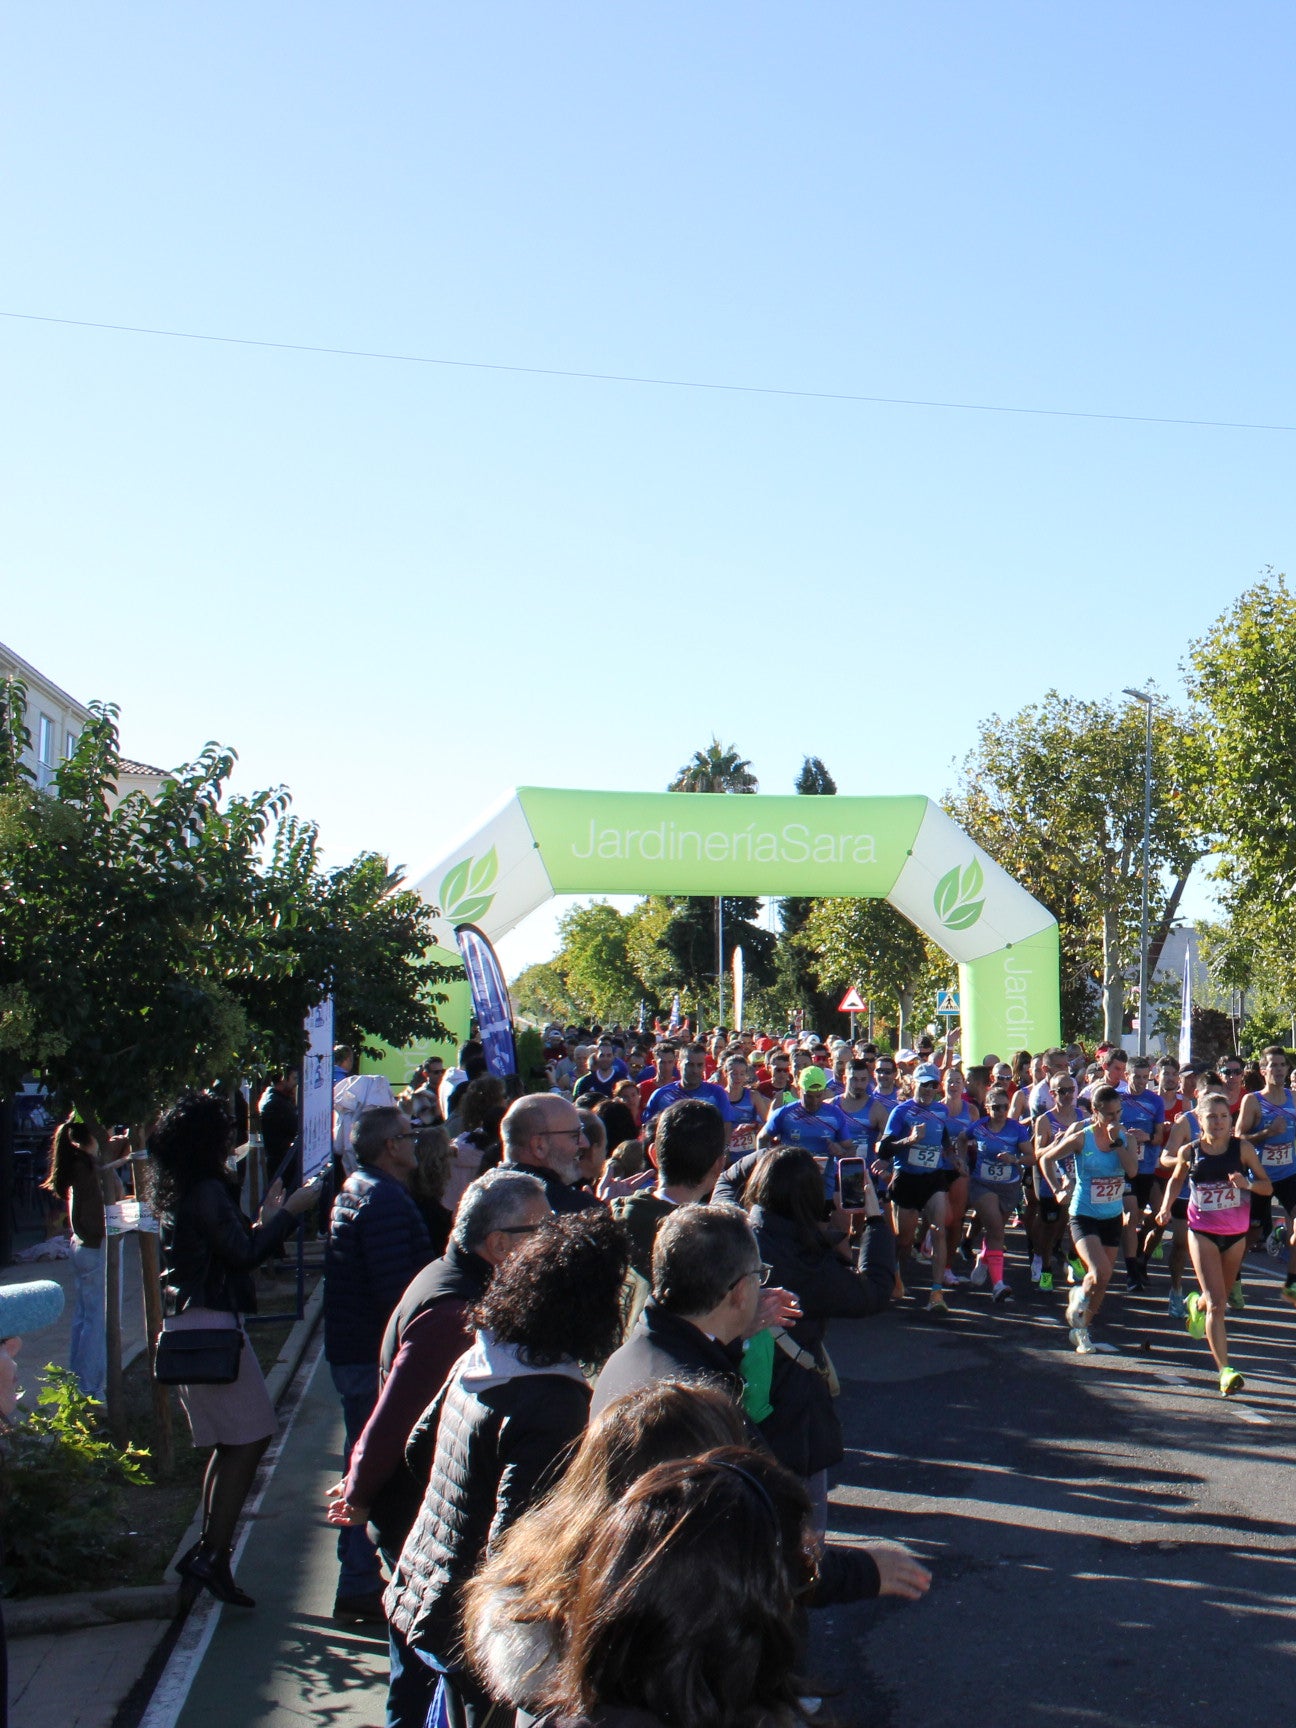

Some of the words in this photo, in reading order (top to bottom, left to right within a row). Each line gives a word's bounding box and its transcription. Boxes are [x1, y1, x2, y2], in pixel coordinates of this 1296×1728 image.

[572, 818, 878, 864] JardineríaSara
[1003, 957, 1035, 1052] Jardin
[917, 1151, 935, 1163] 52
[1267, 1149, 1289, 1161] 231
[987, 1165, 1004, 1177] 63
[1096, 1183, 1122, 1198] 227
[1203, 1189, 1236, 1204] 274
